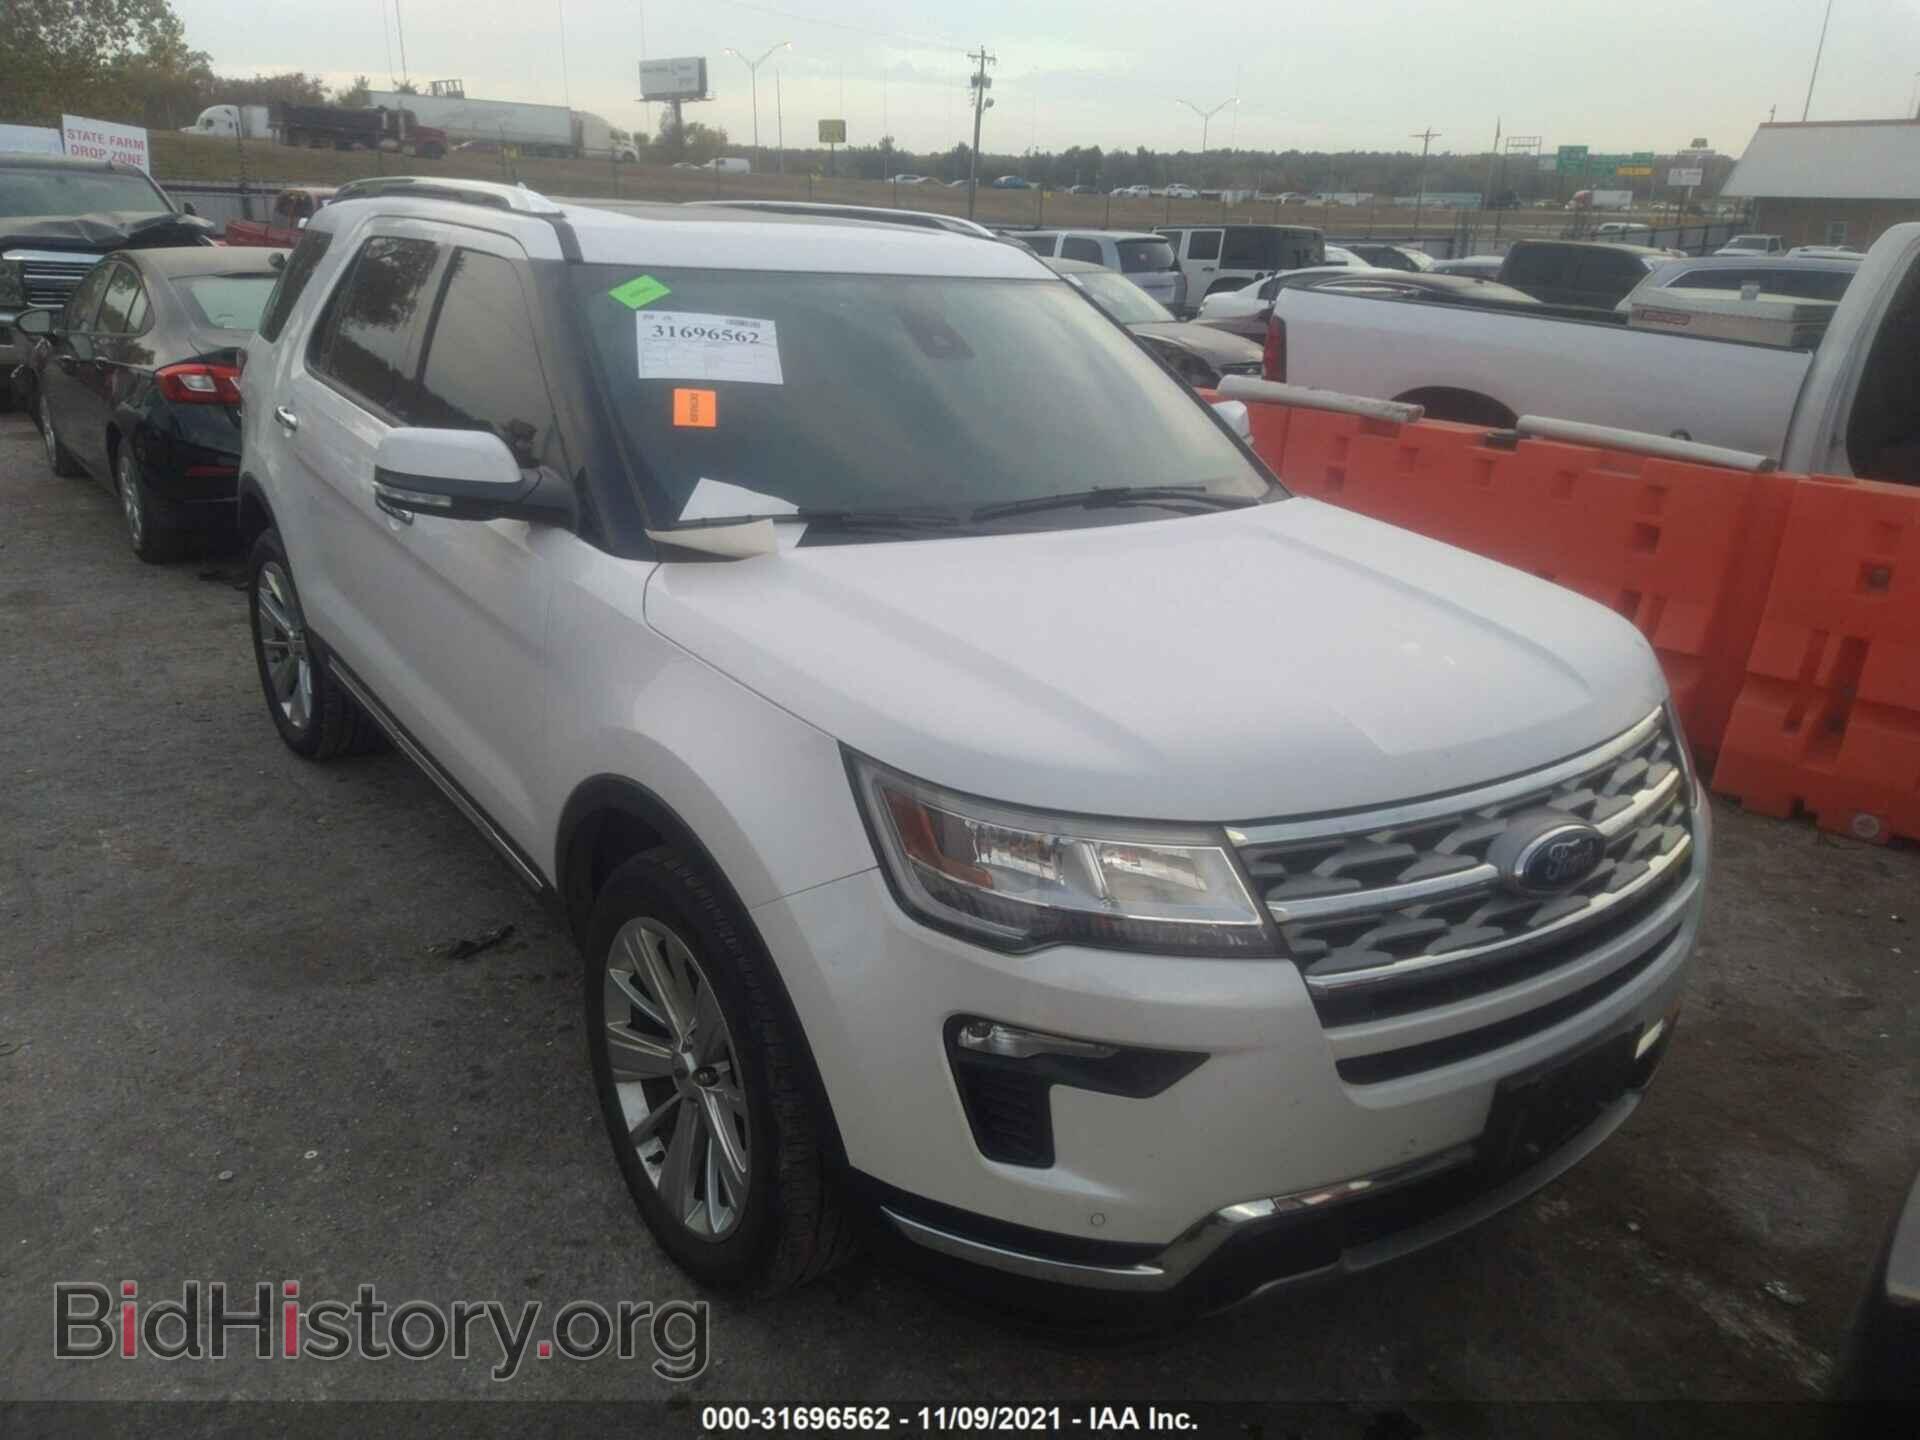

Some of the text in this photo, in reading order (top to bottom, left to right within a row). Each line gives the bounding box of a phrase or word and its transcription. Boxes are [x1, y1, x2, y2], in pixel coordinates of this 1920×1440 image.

[67, 129, 144, 151] STATE FARM
[71, 144, 144, 165] DROP ZONE
[651, 324, 761, 345] 31696562
